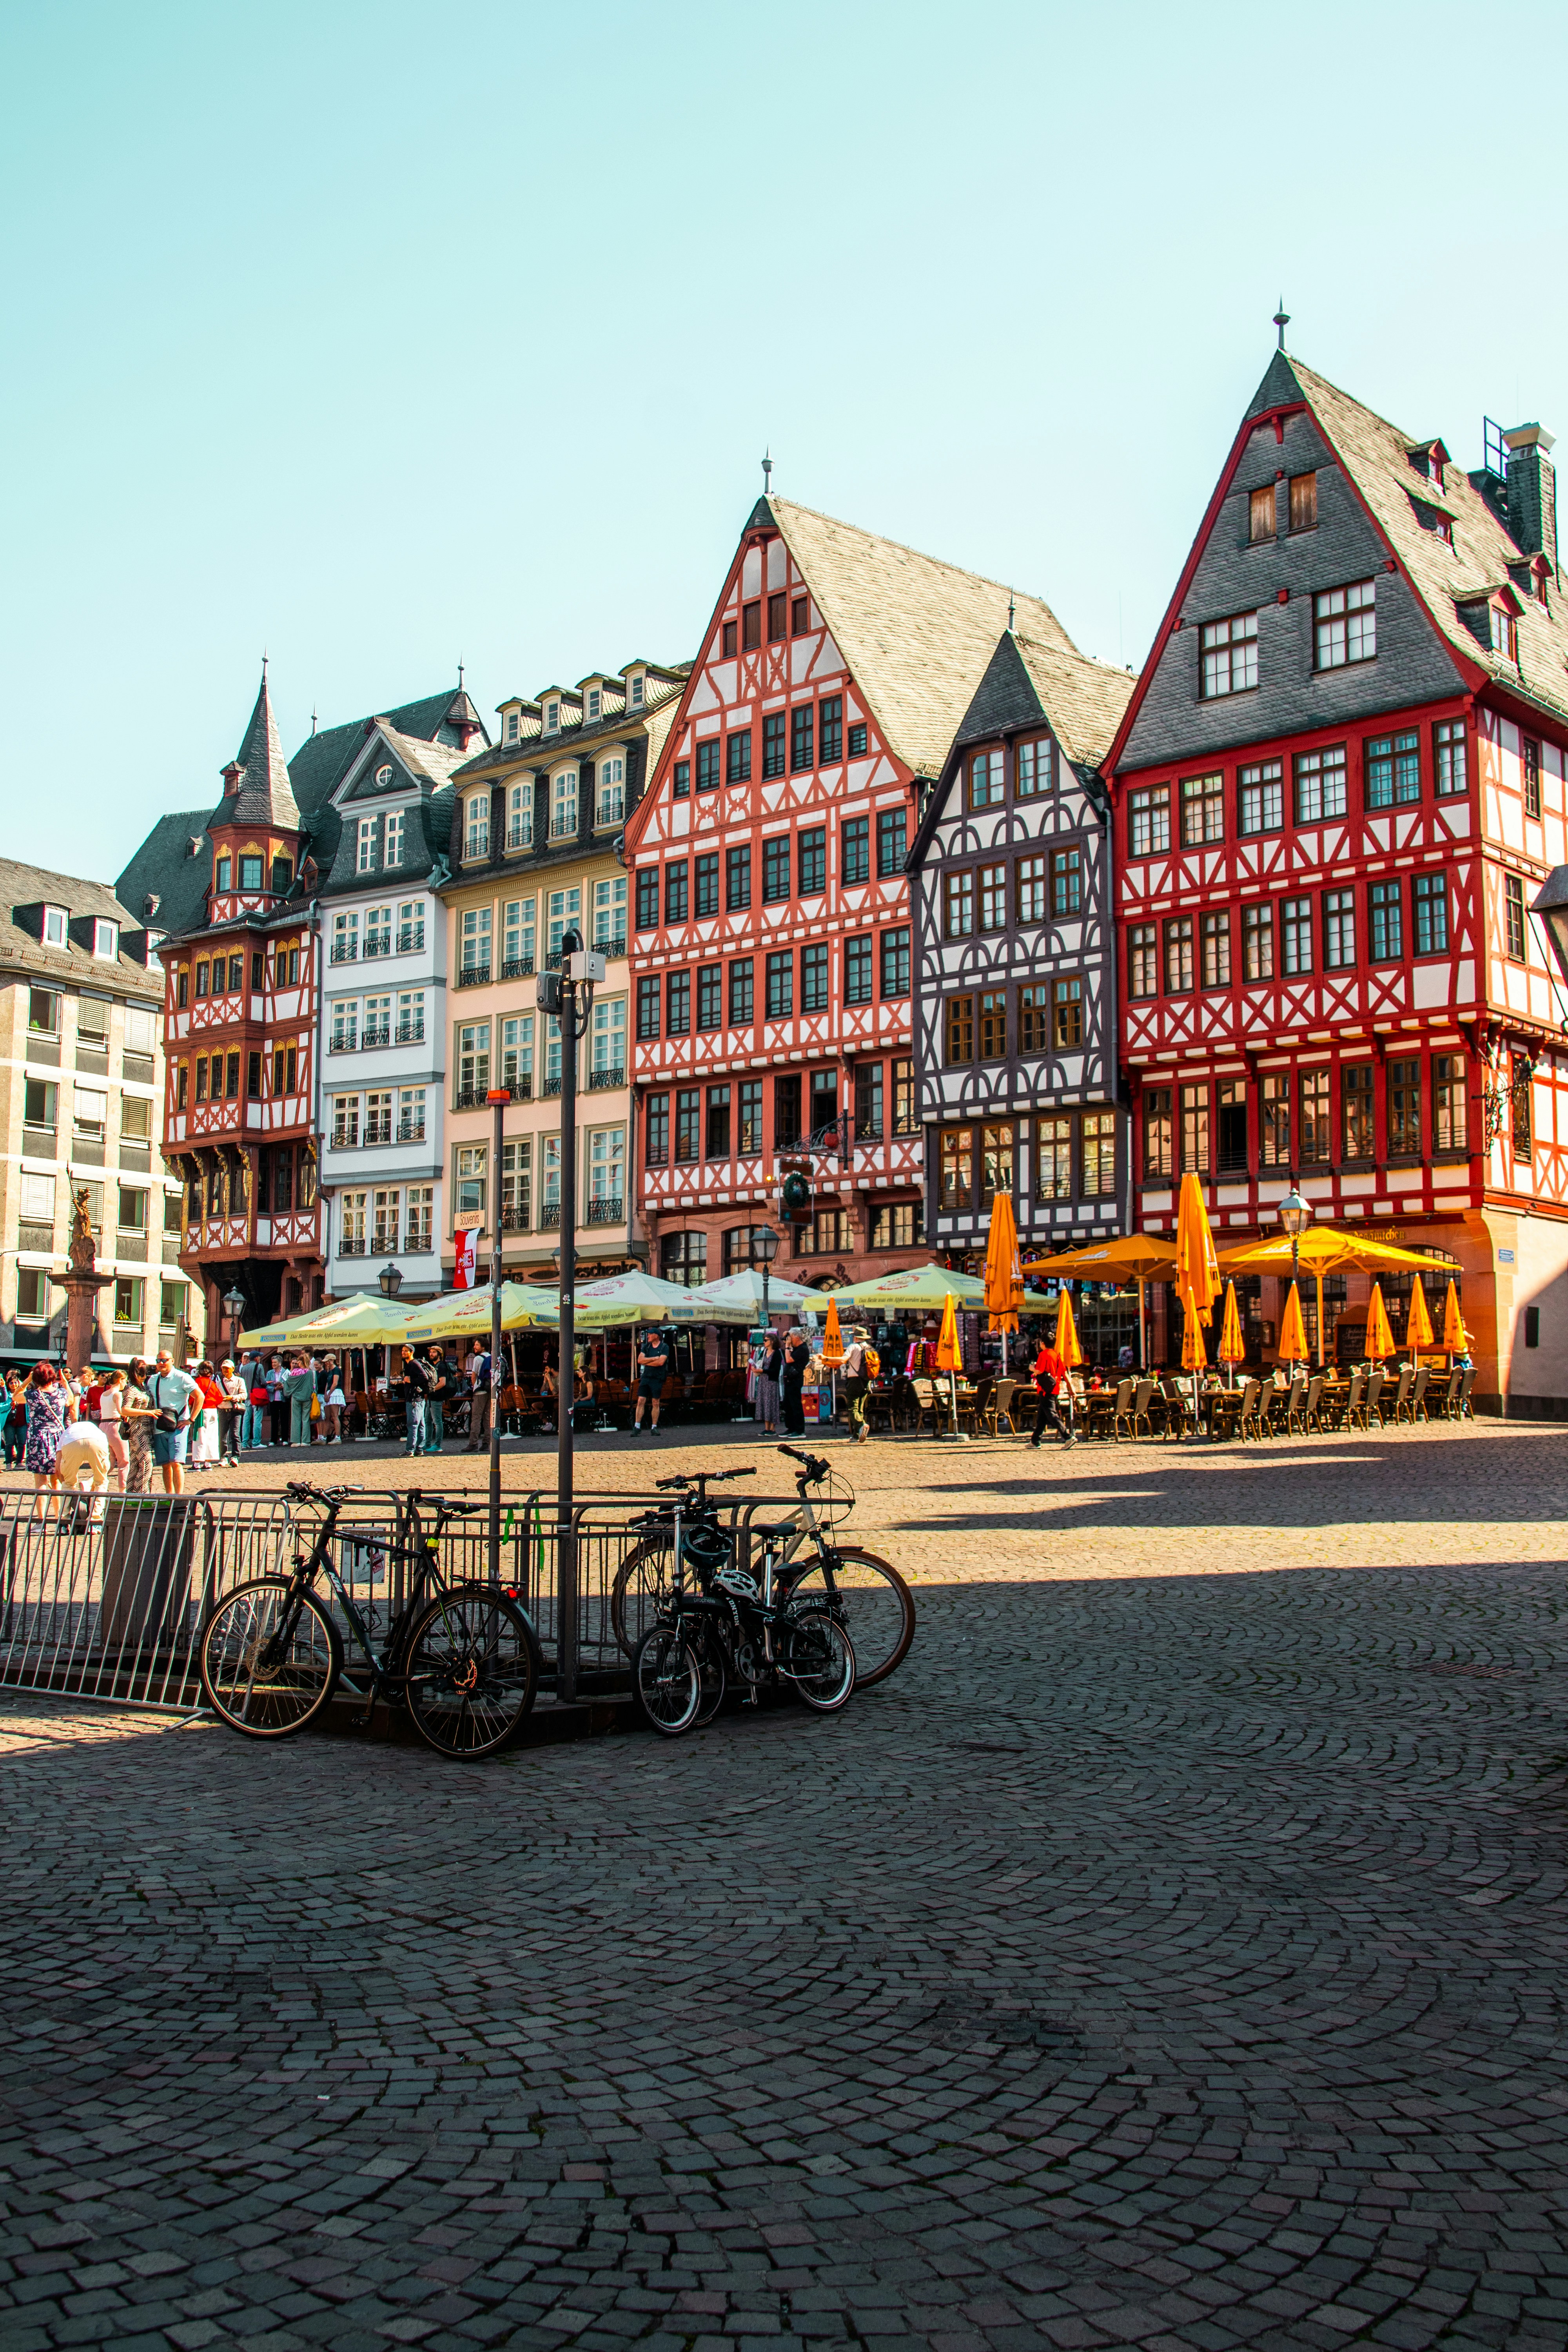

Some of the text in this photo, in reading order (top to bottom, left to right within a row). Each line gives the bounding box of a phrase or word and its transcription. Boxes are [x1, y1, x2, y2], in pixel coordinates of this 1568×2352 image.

[460, 1213, 479, 1225] Souvenirs
[575, 1260, 638, 1278] eschenke
[328, 1572, 343, 1593] KTM
